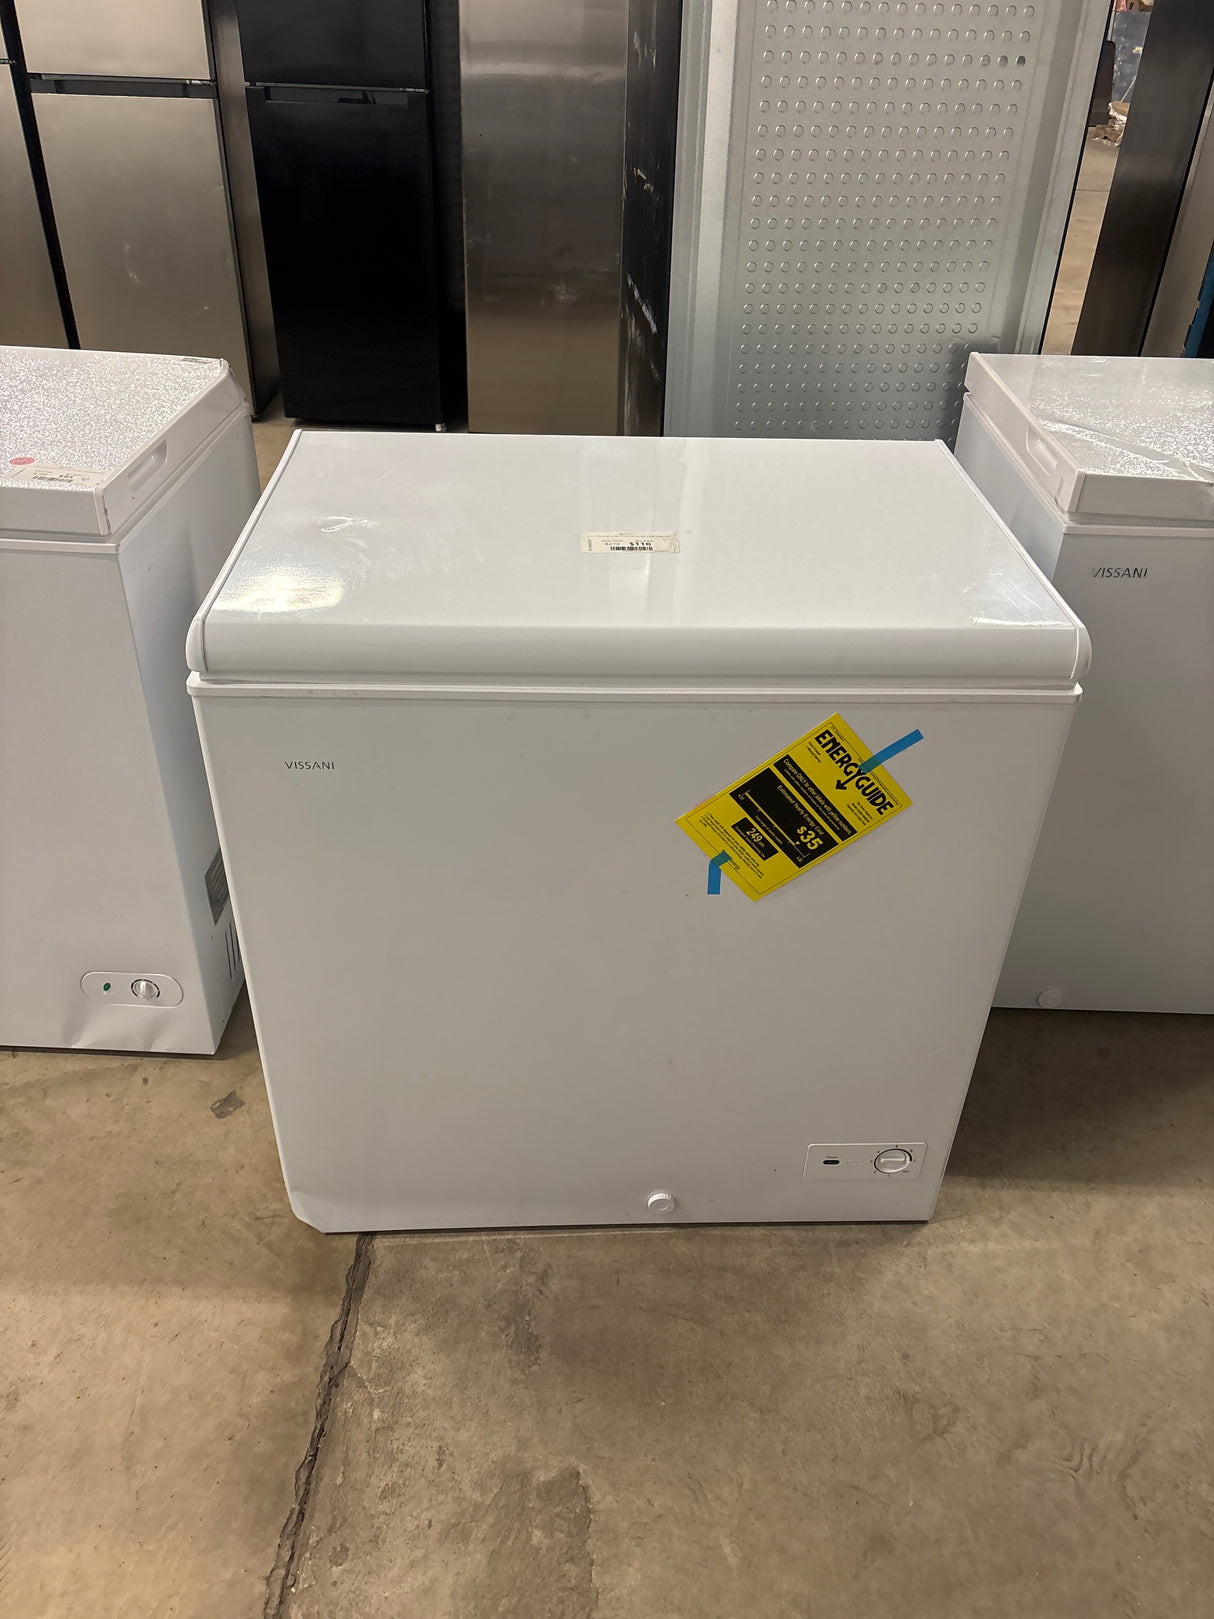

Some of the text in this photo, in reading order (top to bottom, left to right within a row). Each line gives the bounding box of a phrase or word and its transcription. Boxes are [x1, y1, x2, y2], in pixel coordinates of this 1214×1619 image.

[1093, 567, 1148, 578] VISSANI
[285, 761, 335, 770] VISSANI
[813, 728, 894, 815] ENERGYGUIDE
[796, 772, 807, 783] ONLY
[776, 784, 824, 836] Estimated Yearly Energy Cost
[746, 828, 763, 843] 249
[796, 826, 823, 850] $35
